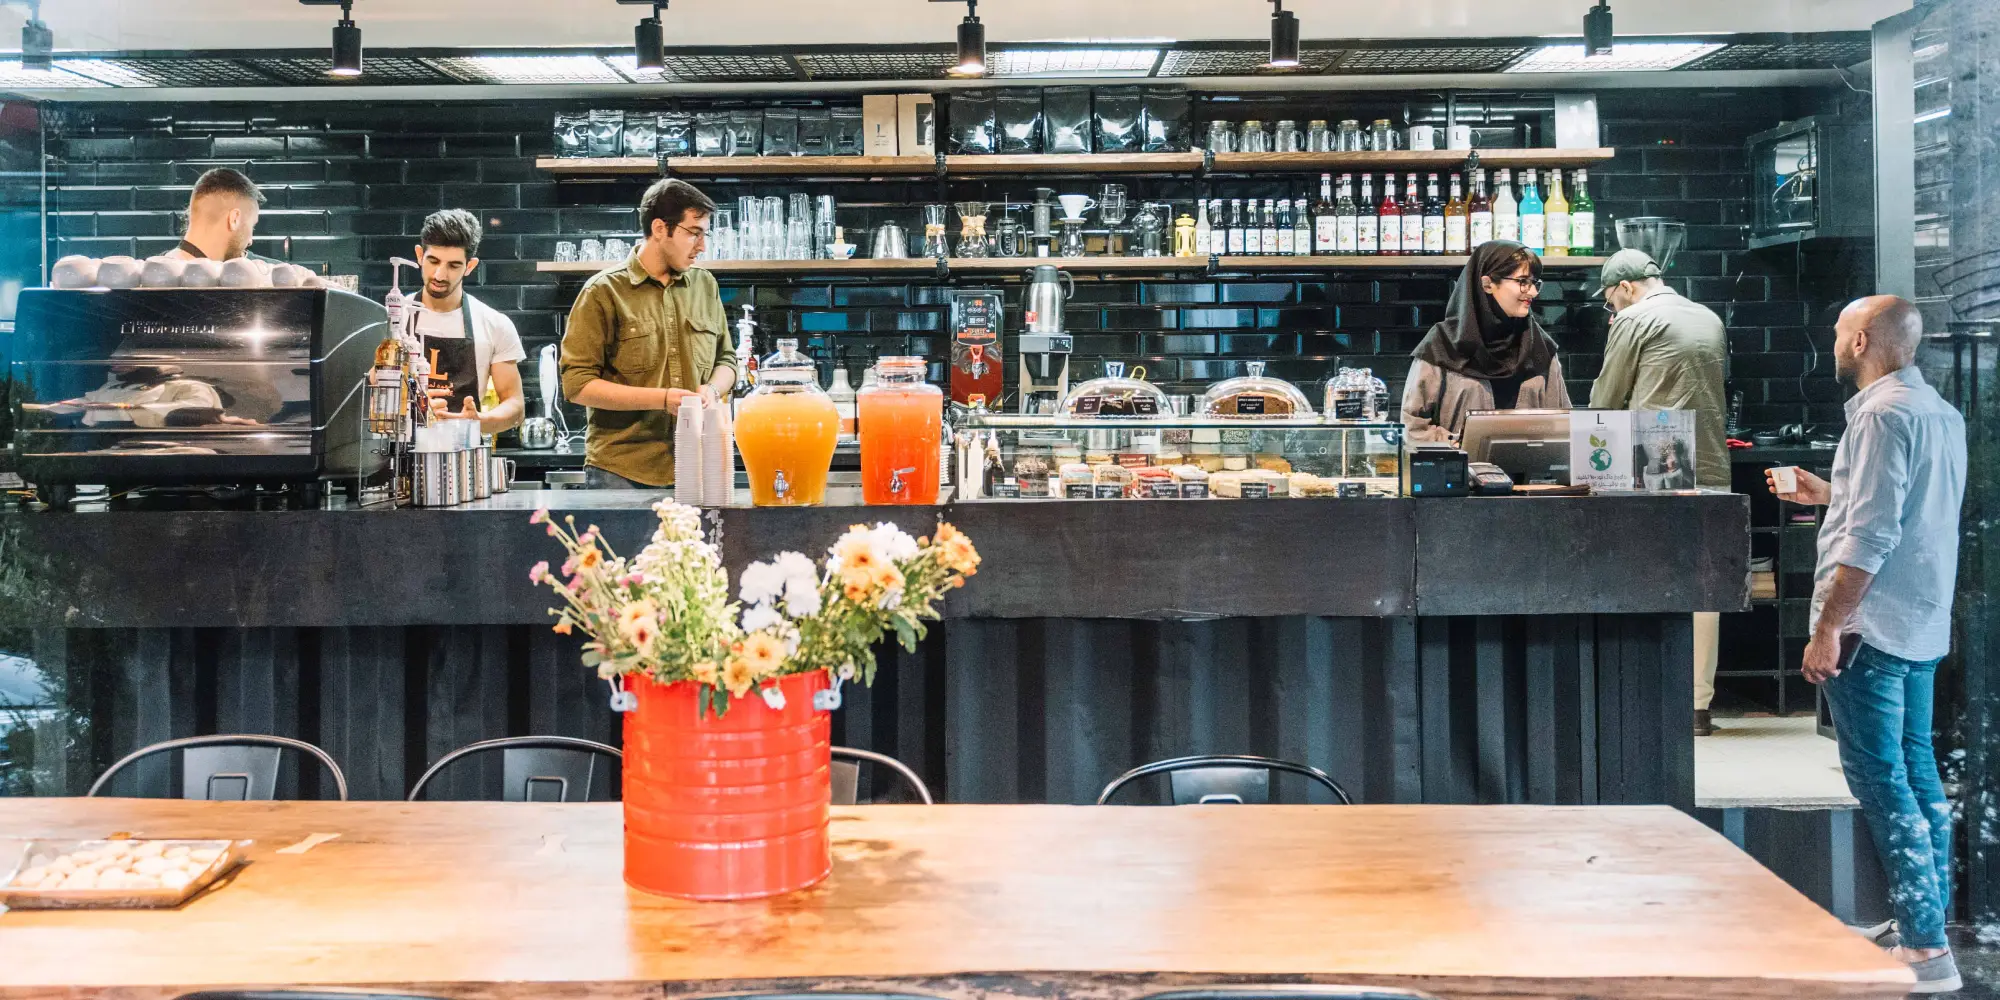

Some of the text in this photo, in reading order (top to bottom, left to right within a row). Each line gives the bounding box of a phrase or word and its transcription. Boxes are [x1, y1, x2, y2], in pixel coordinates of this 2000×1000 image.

[1418, 132, 1423, 140] L
[1456, 132, 1462, 140] L
[428, 348, 448, 380] L
[1597, 413, 1604, 424] L
[1778, 472, 1786, 481] L
